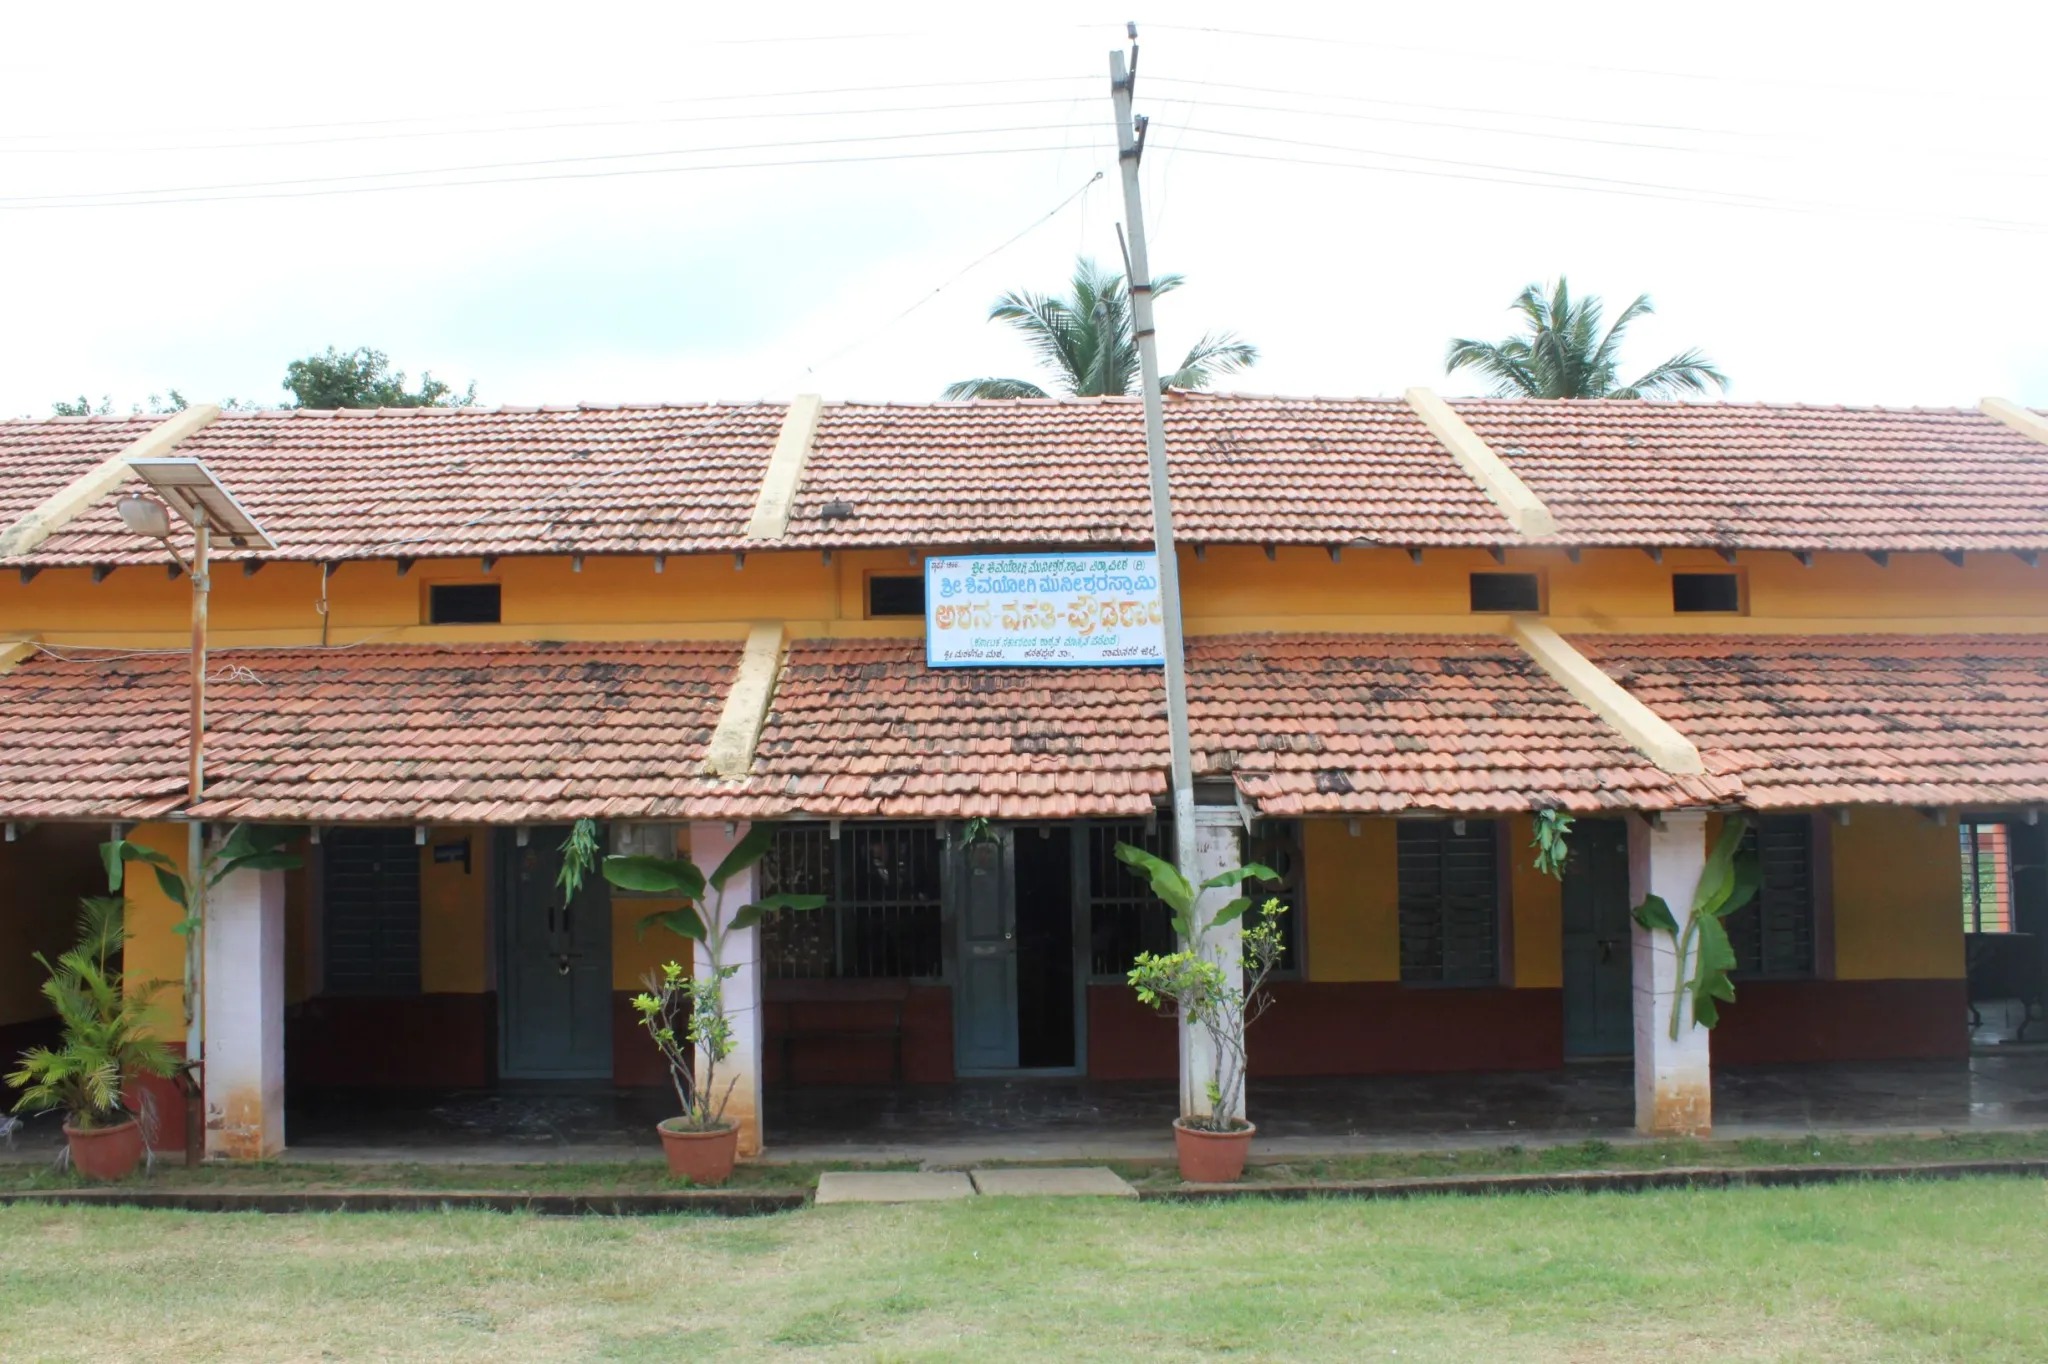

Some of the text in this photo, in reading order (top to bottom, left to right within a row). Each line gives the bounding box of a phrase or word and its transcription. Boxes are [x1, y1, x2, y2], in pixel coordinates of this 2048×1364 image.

[971, 561, 984, 576] ಶ್ರೀ
[940, 574, 1157, 598] ಶ್ರೀ ಶಿವಯೋಗಿ ಮುನೀಶ್ವರಸ್ವಾಮಿ
